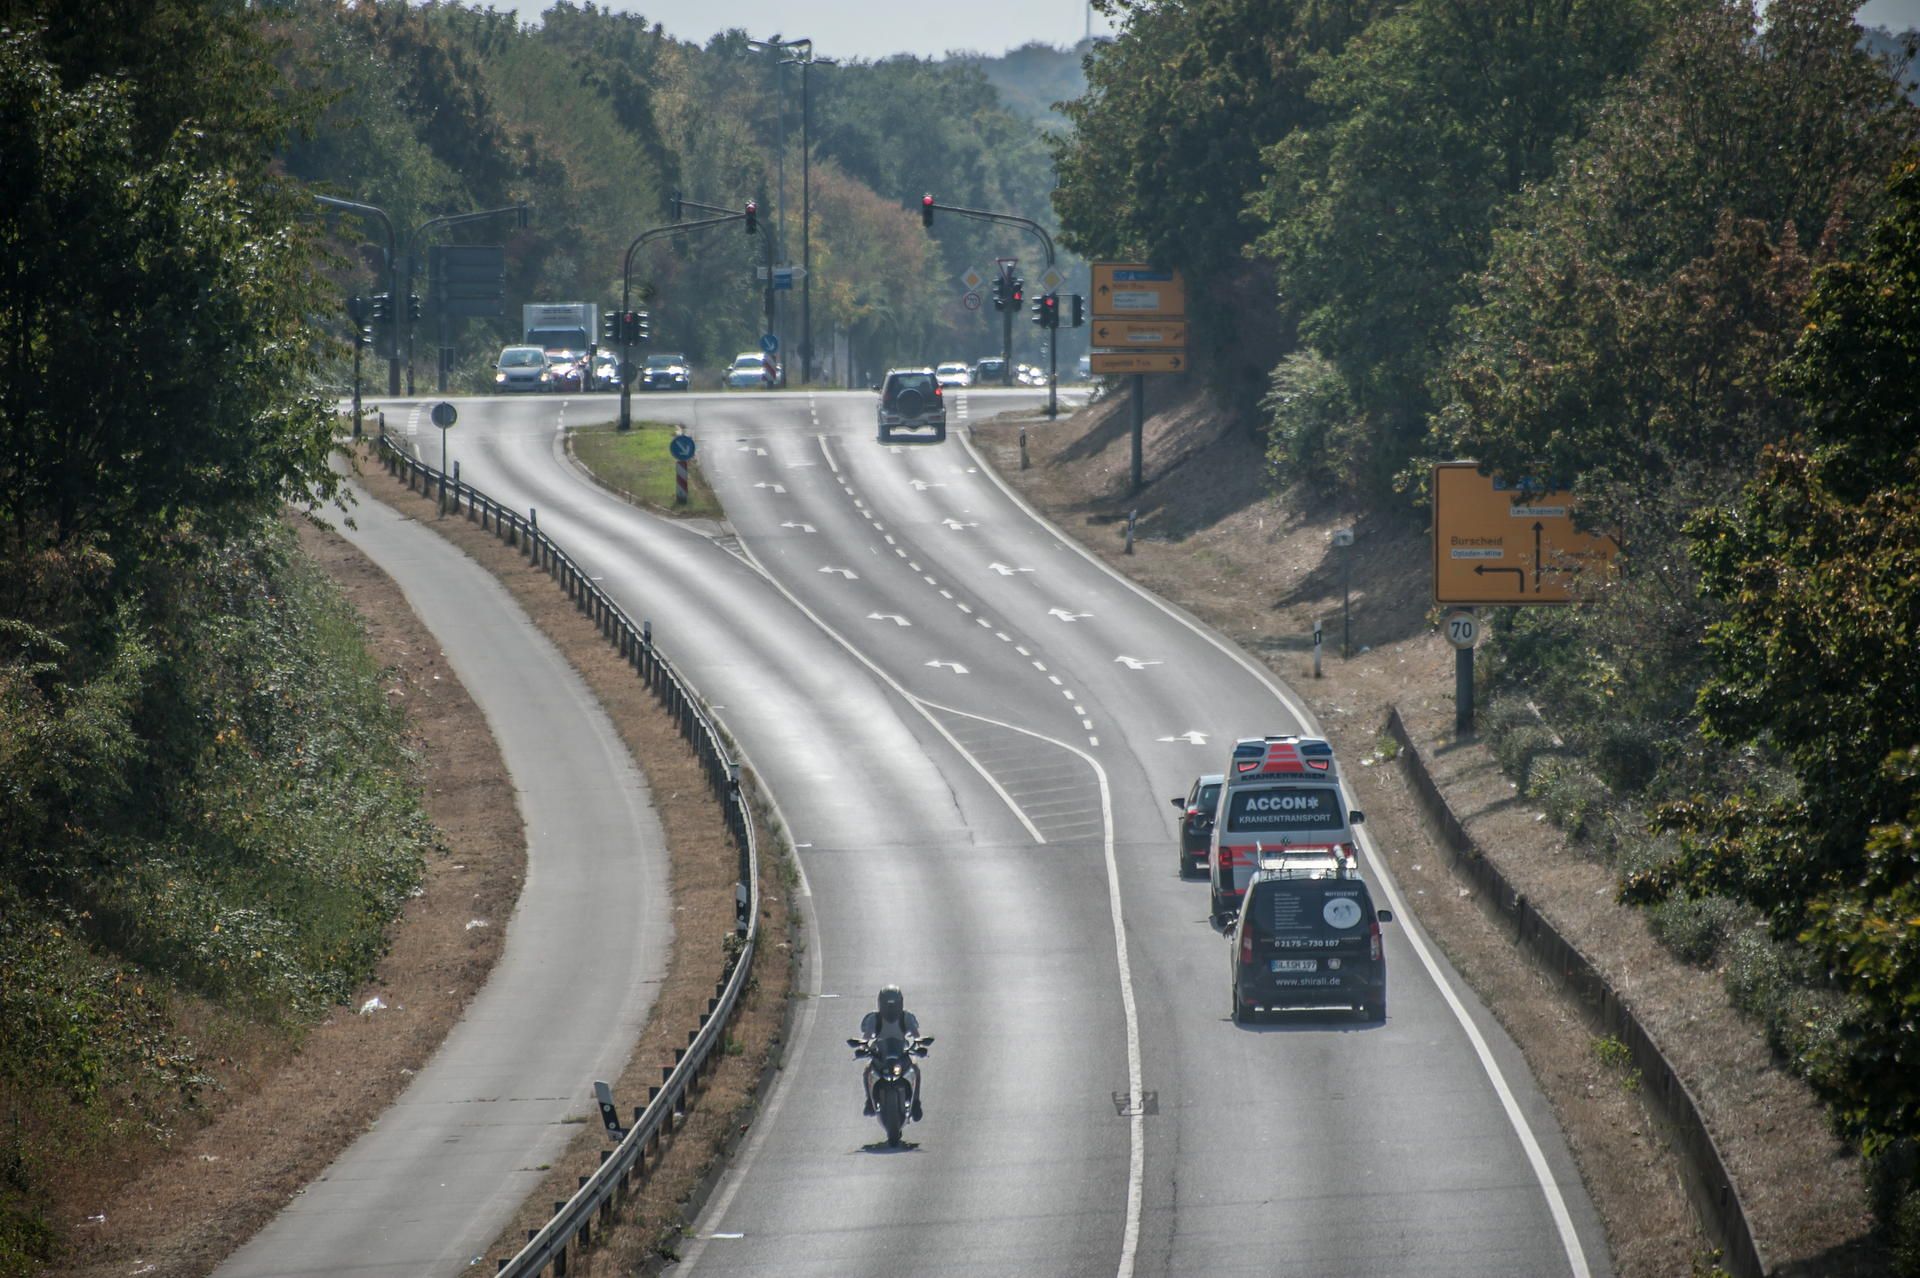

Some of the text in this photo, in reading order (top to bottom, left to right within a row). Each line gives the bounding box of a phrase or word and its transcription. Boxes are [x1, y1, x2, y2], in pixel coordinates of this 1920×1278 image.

[1451, 536, 1503, 546] Burscheid
[1451, 622, 1472, 639] 70
[1241, 772, 1326, 782] KRANKENWAGEN
[1246, 796, 1307, 811] ACCON
[1239, 814, 1331, 824] KRANKENTRANSPORT
[1275, 976, 1341, 986] www.shirali.de
